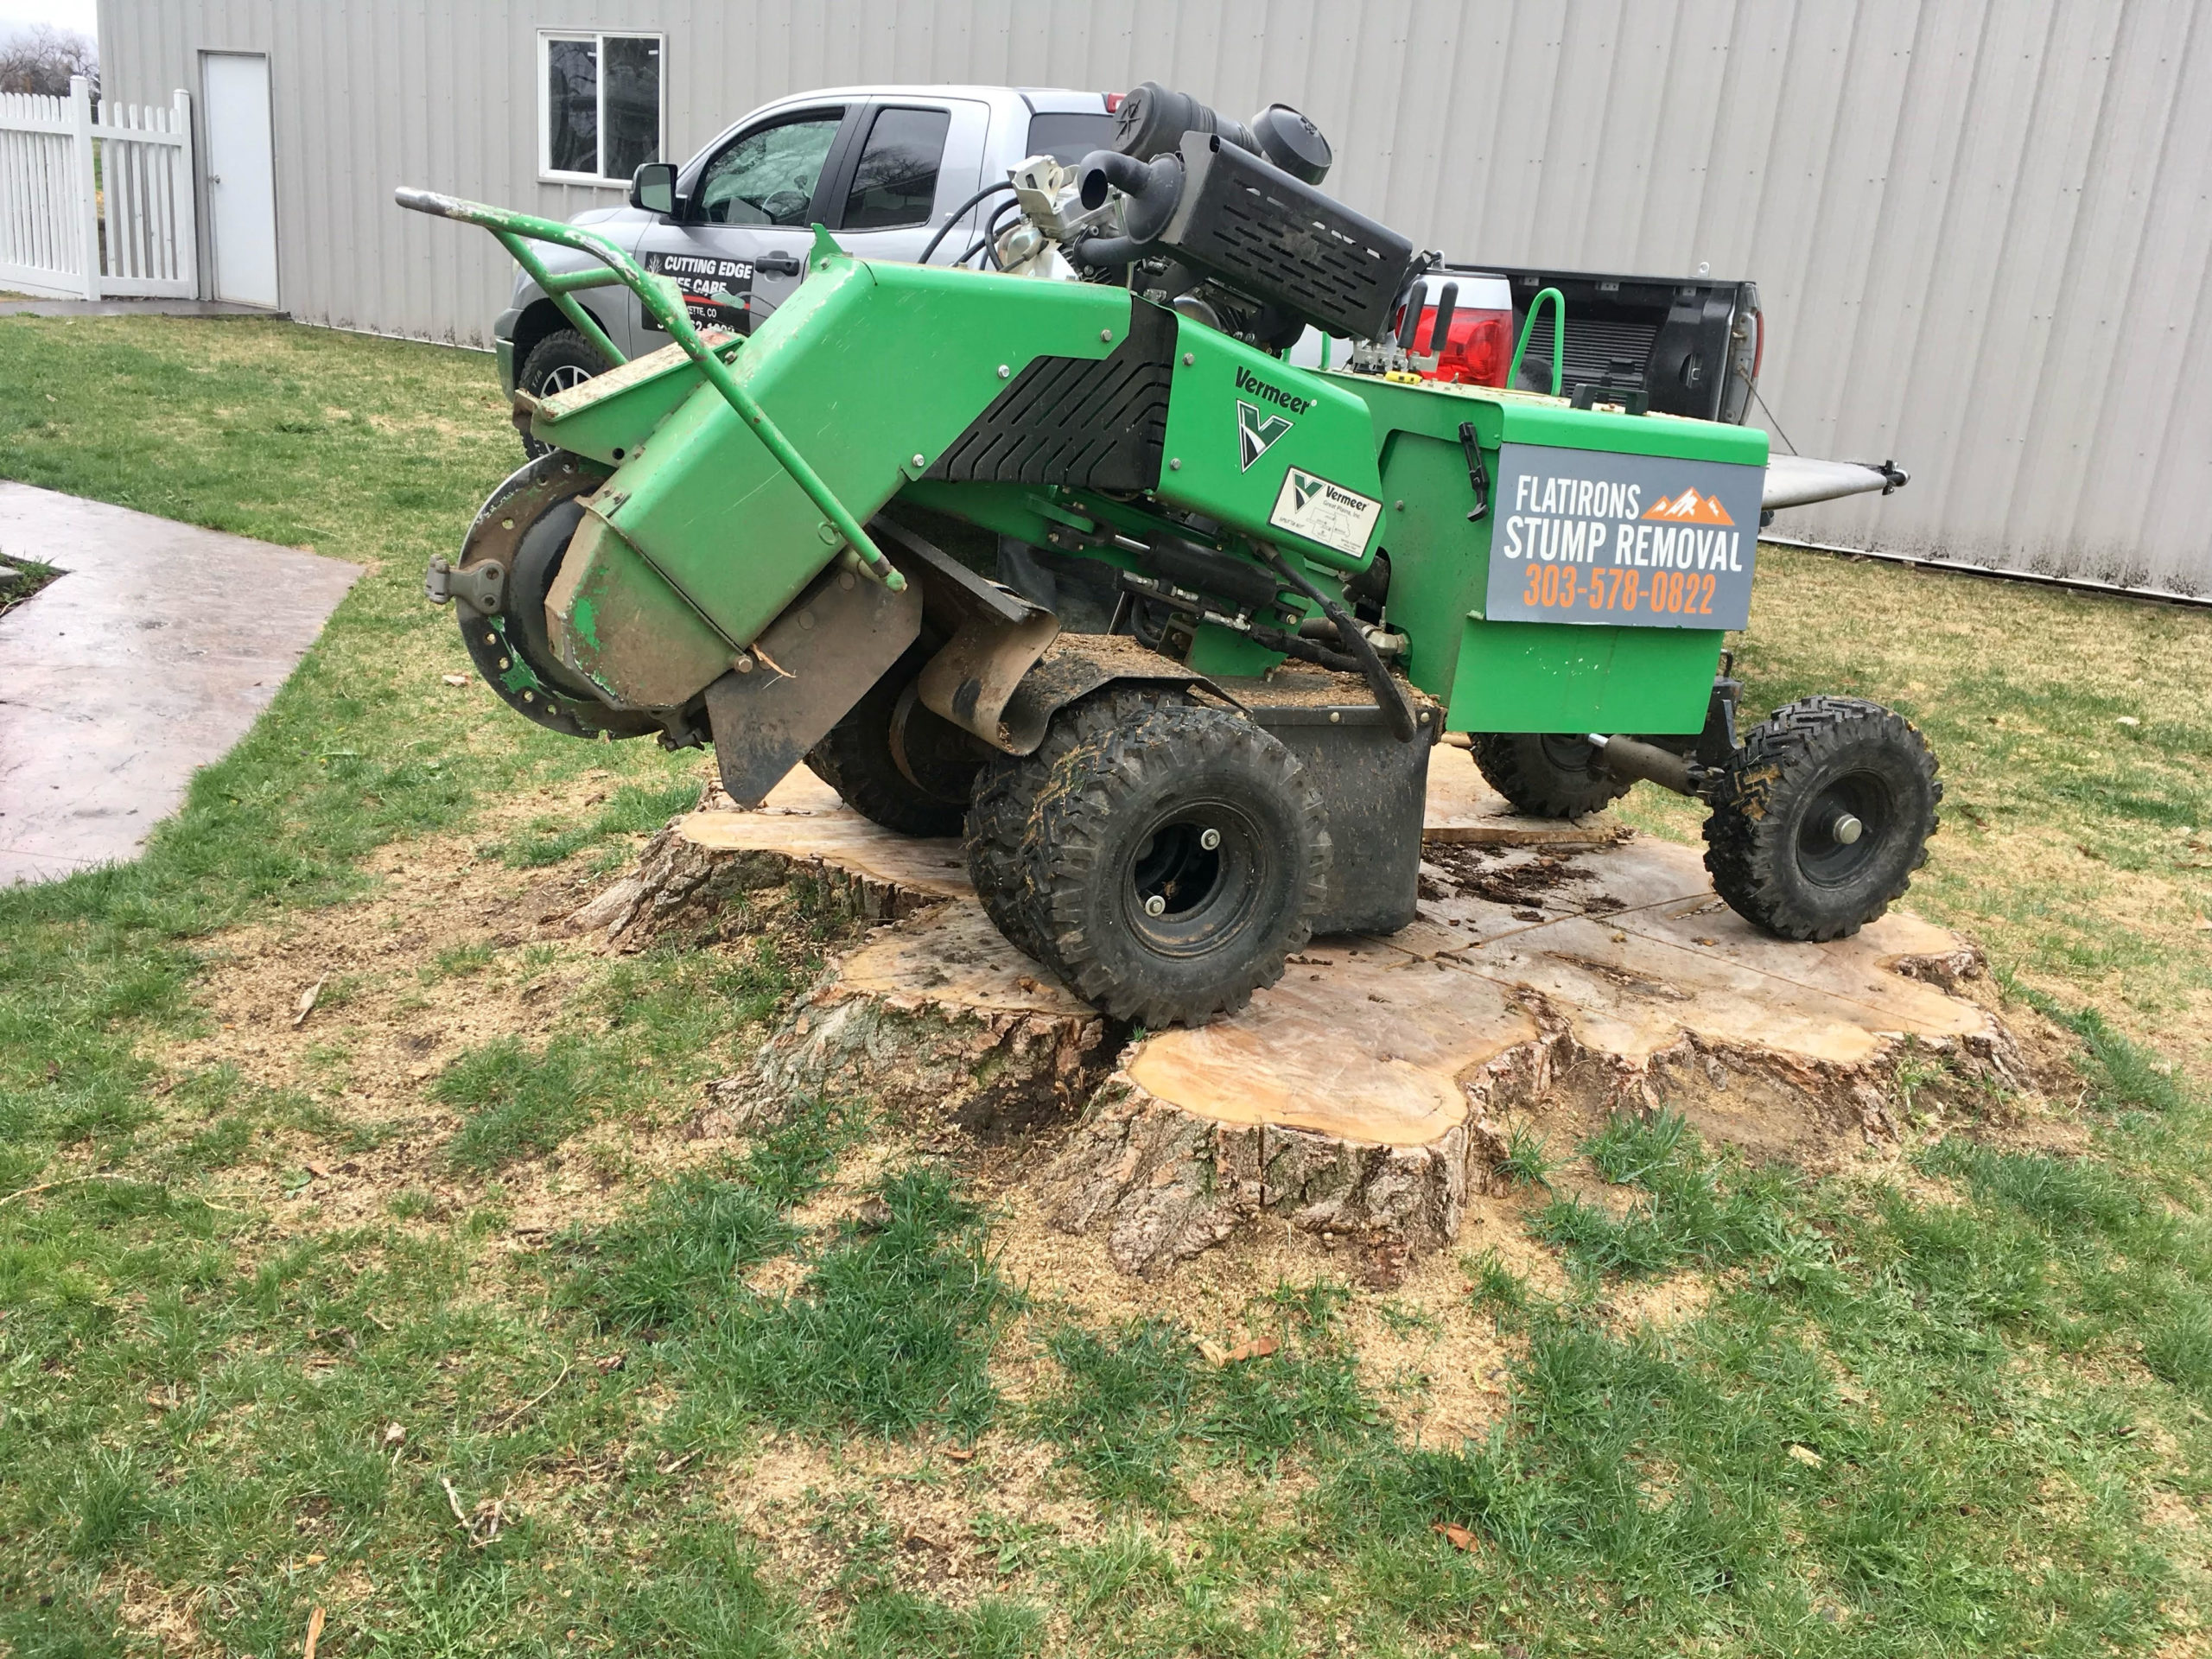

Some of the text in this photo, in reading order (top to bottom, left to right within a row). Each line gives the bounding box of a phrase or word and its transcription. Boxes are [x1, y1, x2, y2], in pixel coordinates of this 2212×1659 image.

[664, 256, 753, 279] CUTTING EDGE
[693, 278, 728, 296] CARE
[707, 308, 717, 318] CO
[1235, 365, 1311, 416] Vermeer
[1323, 499, 1337, 510] Great
[1326, 485, 1367, 512] Vermeer
[1515, 474, 1642, 520] FLATIRONS
[1503, 515, 1743, 572] STUMP REMOVAL
[1523, 563, 1717, 615] 303-578-0822
